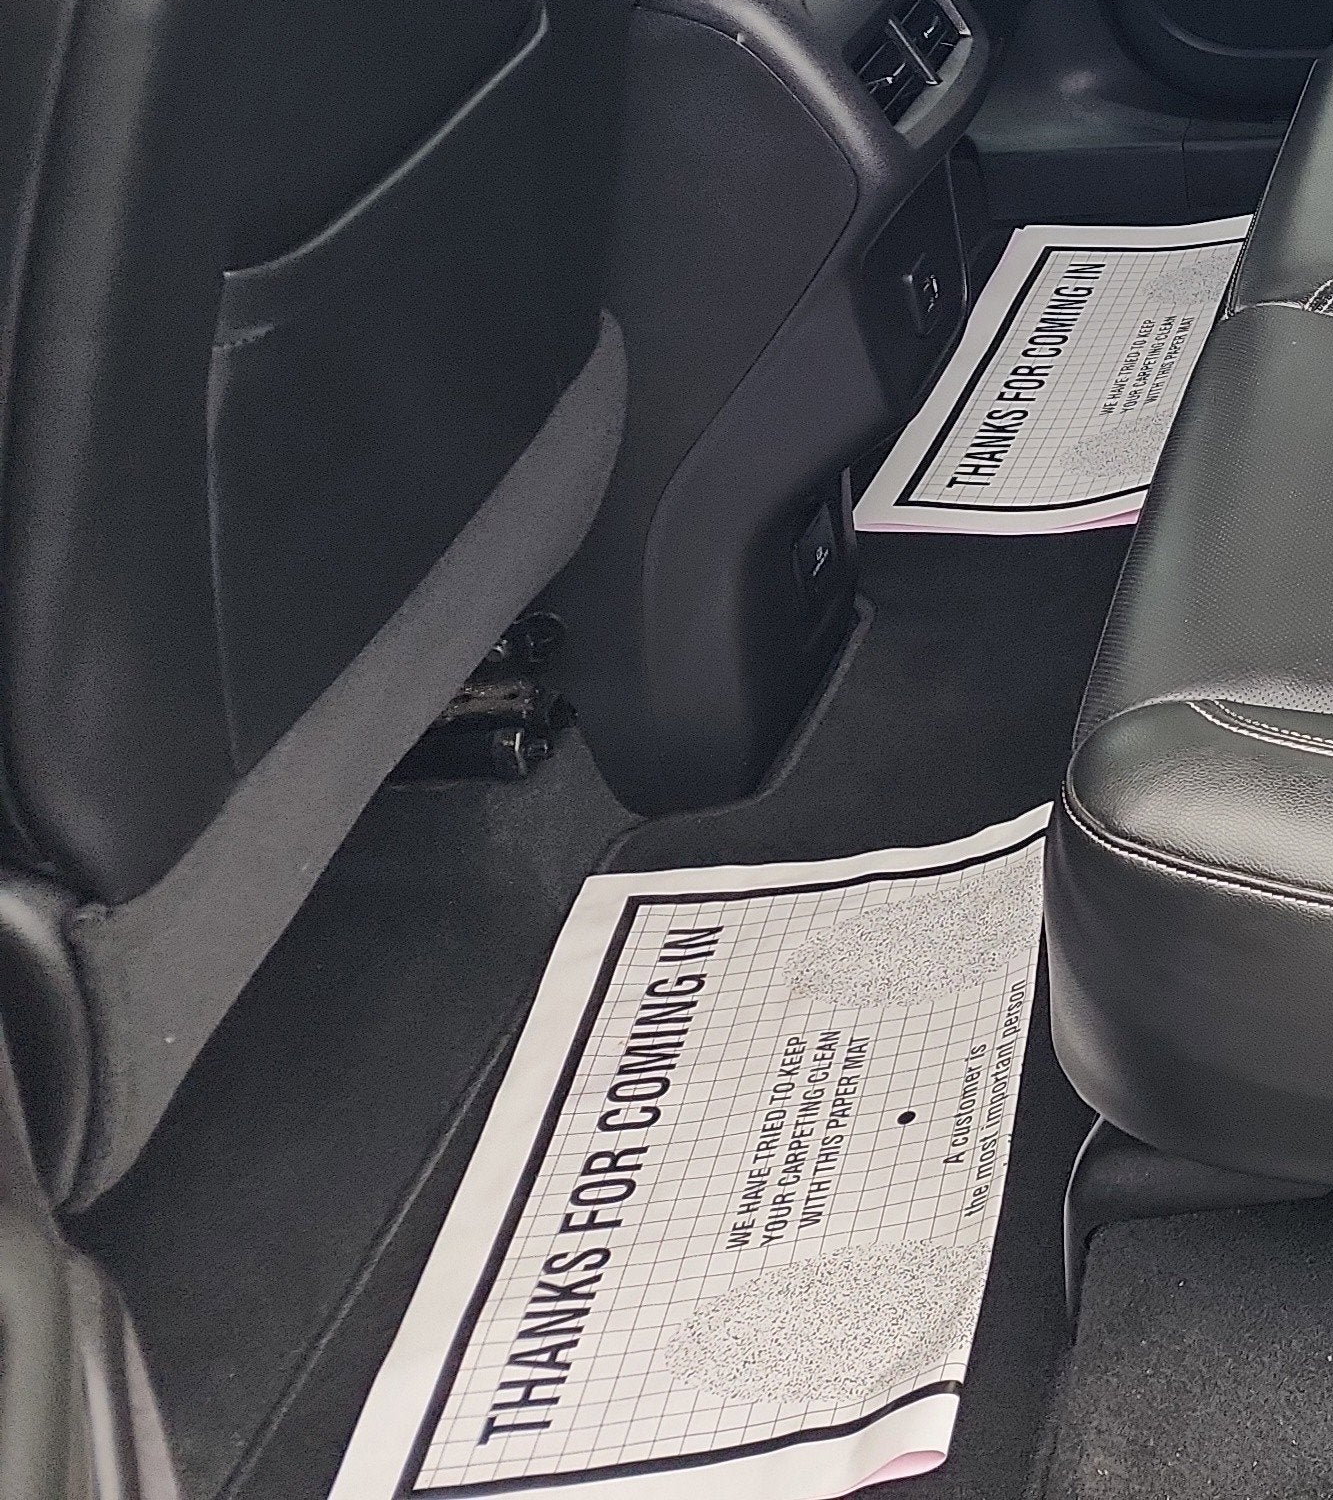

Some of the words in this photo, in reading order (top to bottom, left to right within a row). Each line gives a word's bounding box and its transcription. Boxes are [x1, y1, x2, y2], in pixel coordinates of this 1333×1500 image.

[1064, 262, 1106, 280] IN
[1021, 285, 1095, 358] COMING
[1136, 319, 1156, 338] KEEP
[1118, 351, 1140, 376] TRIED
[1120, 389, 1143, 414] YOUR
[1133, 342, 1165, 387] CARPETING
[1155, 315, 1177, 340] CLEAN
[1130, 339, 1147, 350] TO
[1143, 381, 1165, 405] WITH
[1154, 361, 1174, 381] THIS
[1164, 334, 1187, 360] PAPER
[1176, 317, 1195, 334] MAT
[996, 363, 1054, 402] FOR
[1107, 377, 1129, 399] HAVE
[1099, 400, 1118, 415] WE
[946, 408, 1029, 488] THANKS
[659, 925, 725, 964] IN
[1002, 980, 1026, 1038] person
[597, 973, 708, 1133] COMING
[777, 1036, 807, 1077] KEEP
[842, 1037, 870, 1070] MAT
[964, 1044, 987, 1062] is
[769, 1082, 795, 1105] TO
[826, 1074, 860, 1129] PAPER
[952, 1065, 982, 1147] customer
[981, 1040, 1015, 1131] important
[753, 1109, 787, 1164] TRIED
[760, 1191, 796, 1248] YOUR
[778, 1088, 825, 1186] CARPETING
[808, 1030, 841, 1083] CLEAN
[813, 1135, 844, 1176] THIS
[943, 1151, 966, 1164] A
[976, 1131, 998, 1180] most
[560, 1143, 650, 1234] FOR
[737, 1166, 771, 1215] HAVE
[798, 1179, 832, 1229] WITH
[964, 1184, 989, 1217] the
[726, 1218, 756, 1249] WE
[476, 1246, 611, 1446] THANKS
